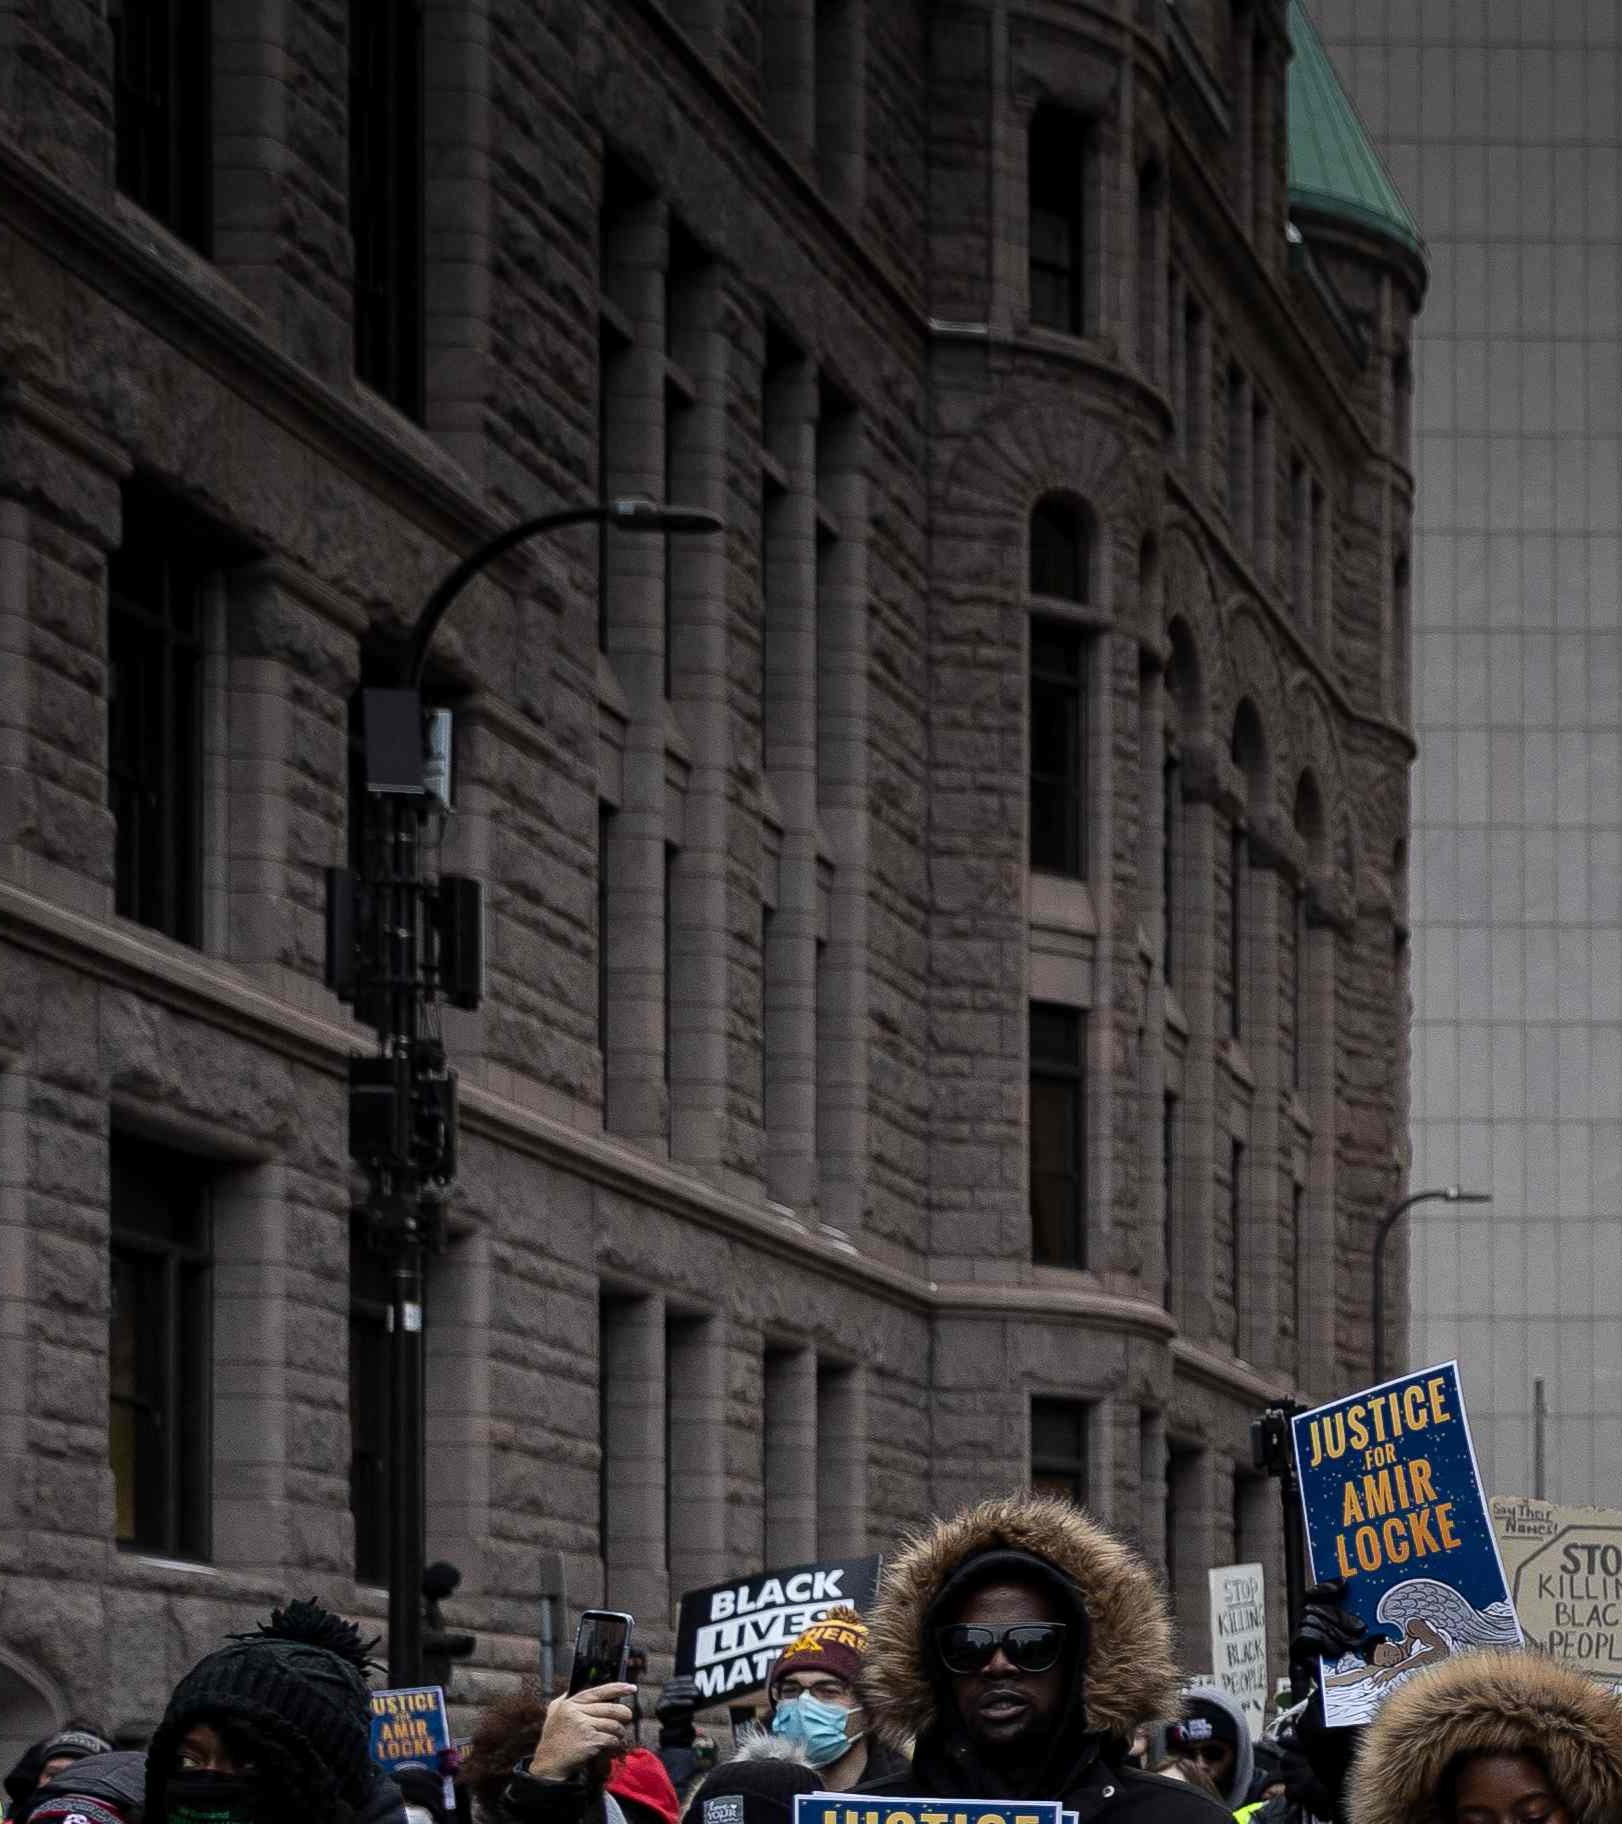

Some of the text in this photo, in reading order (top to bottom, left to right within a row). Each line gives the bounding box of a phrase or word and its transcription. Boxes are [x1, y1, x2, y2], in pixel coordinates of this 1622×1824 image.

[1310, 1377, 1451, 1468] JUSTICE
[1364, 1442, 1398, 1470] FOR
[1343, 1459, 1438, 1527] AMIR
[1493, 1502, 1552, 1521] Say Their
[1336, 1502, 1463, 1579] LOCKE
[710, 1568, 845, 1623] BLACK
[1224, 1576, 1259, 1603] STOP
[695, 1648, 784, 1698] MAT
[1227, 1639, 1265, 1668] BLACK
